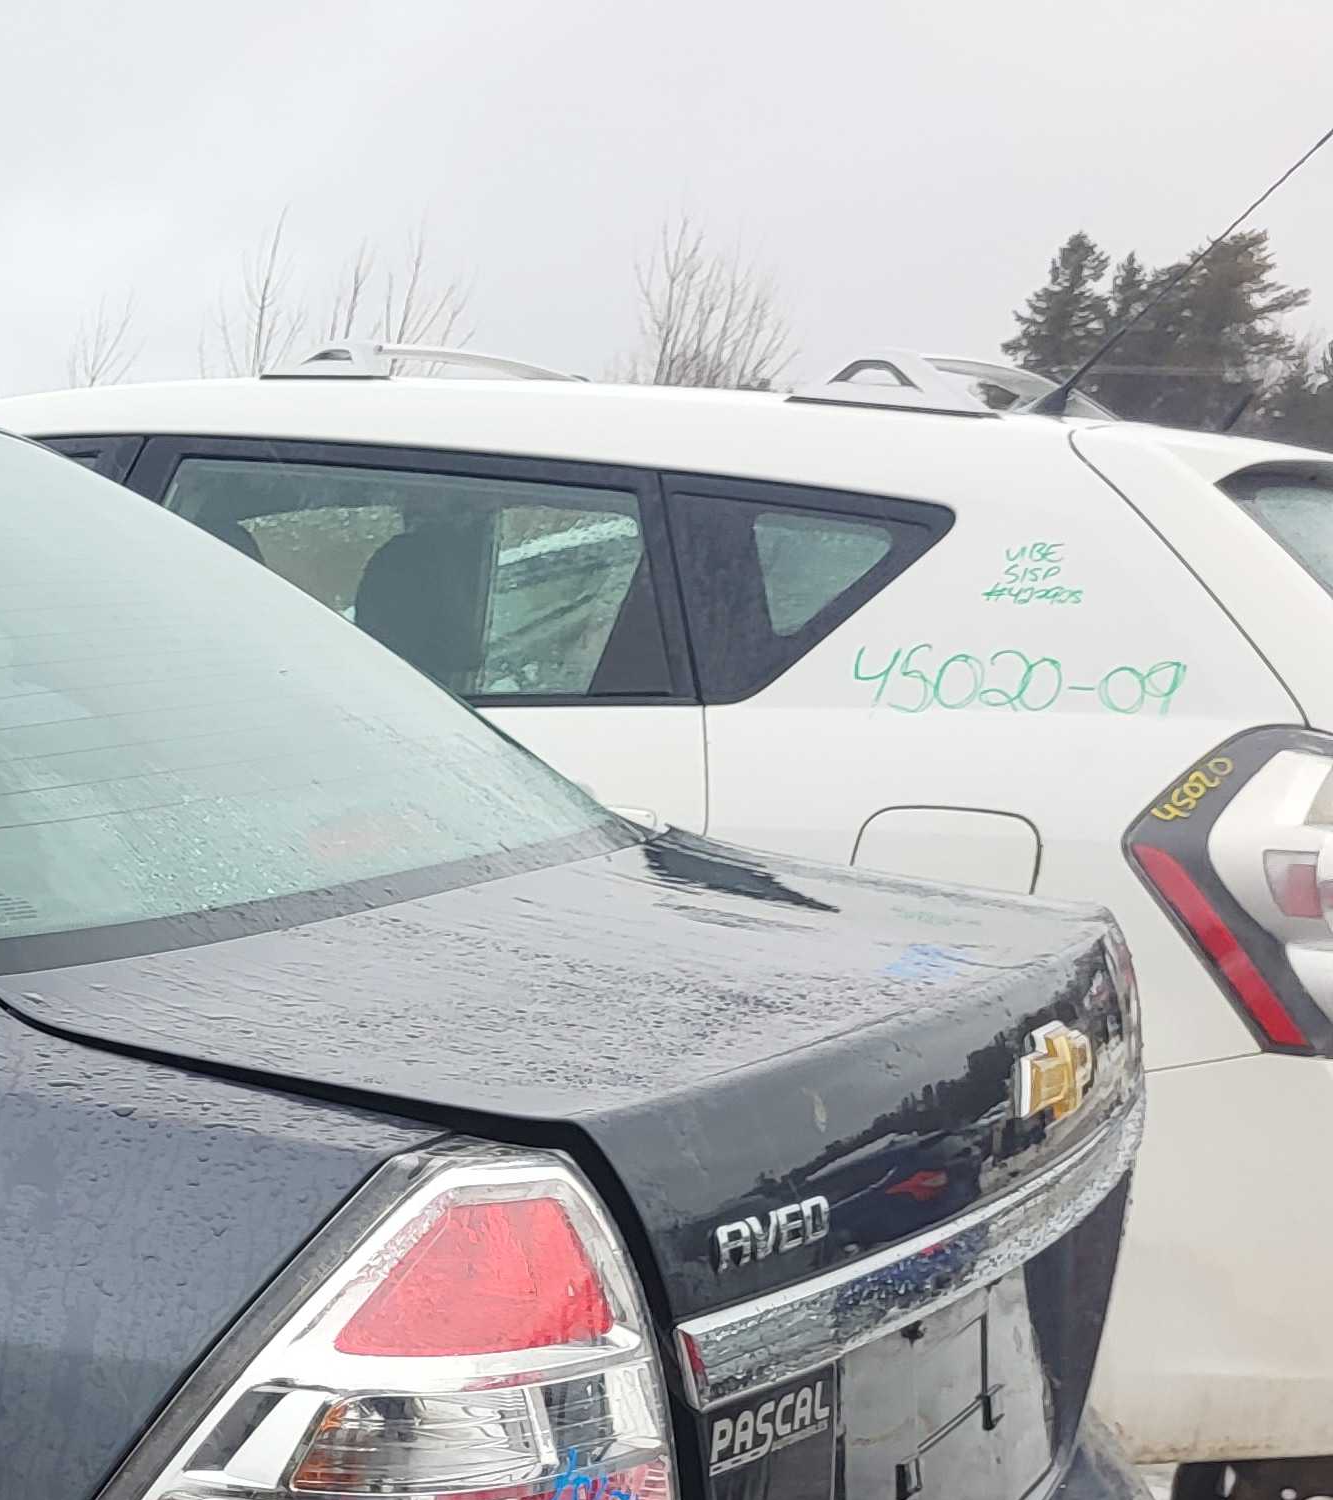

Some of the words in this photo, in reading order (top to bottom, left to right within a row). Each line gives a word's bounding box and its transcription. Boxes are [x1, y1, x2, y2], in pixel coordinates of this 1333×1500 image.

[854, 643, 1187, 718] 45020-09
[1150, 756, 1234, 821] 45020
[709, 1380, 831, 1470] PASCAL
